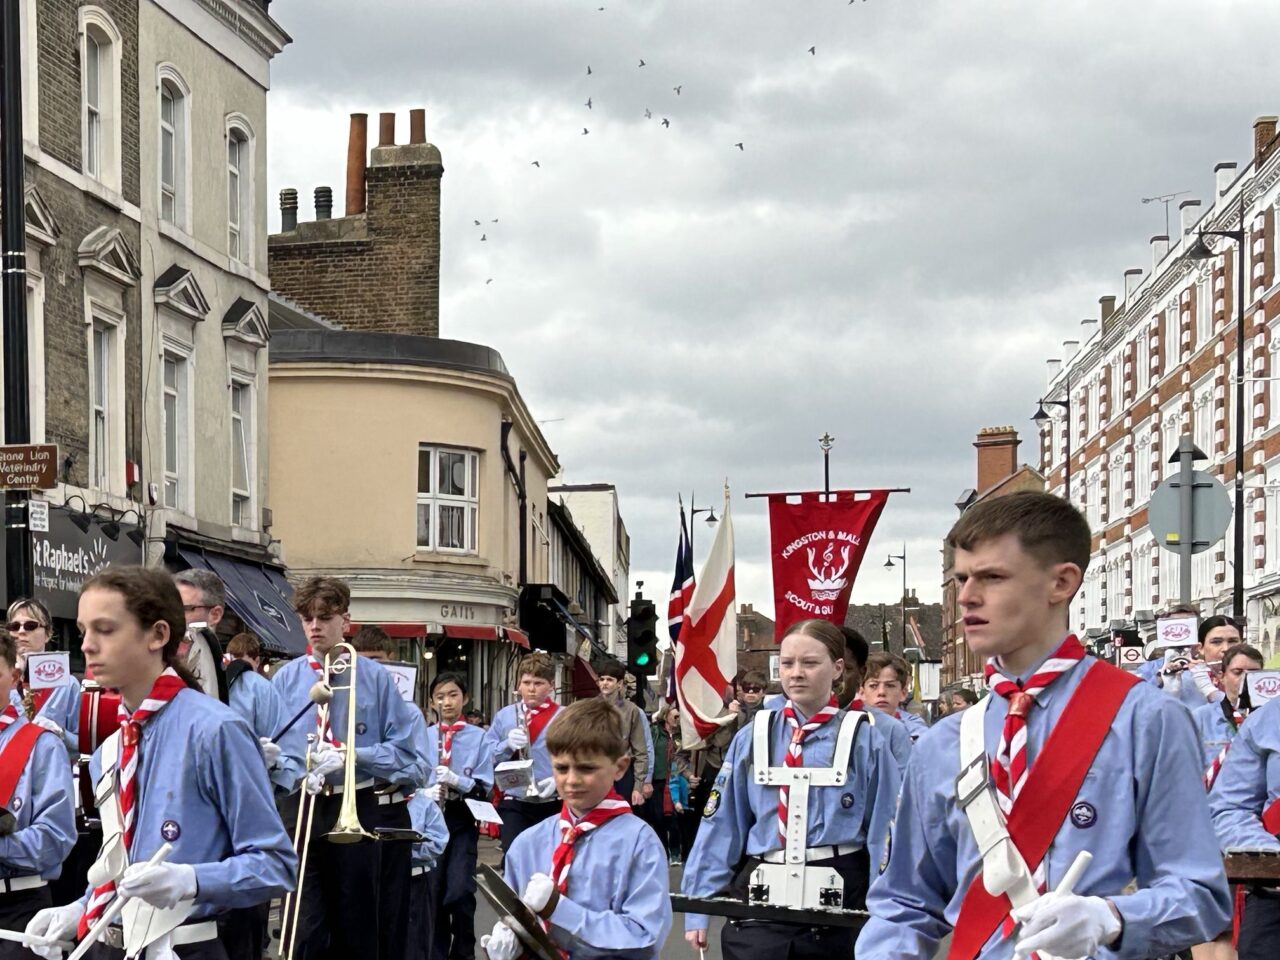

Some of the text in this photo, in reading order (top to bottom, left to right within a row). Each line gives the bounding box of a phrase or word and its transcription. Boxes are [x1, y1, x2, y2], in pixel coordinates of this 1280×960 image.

[30, 451, 50, 460] Lion
[7, 473, 39, 484] Centre
[781, 531, 827, 559] KINGSTON
[828, 530, 835, 539] &
[43, 539, 88, 577] Raphael's
[785, 590, 815, 611] SCOUT
